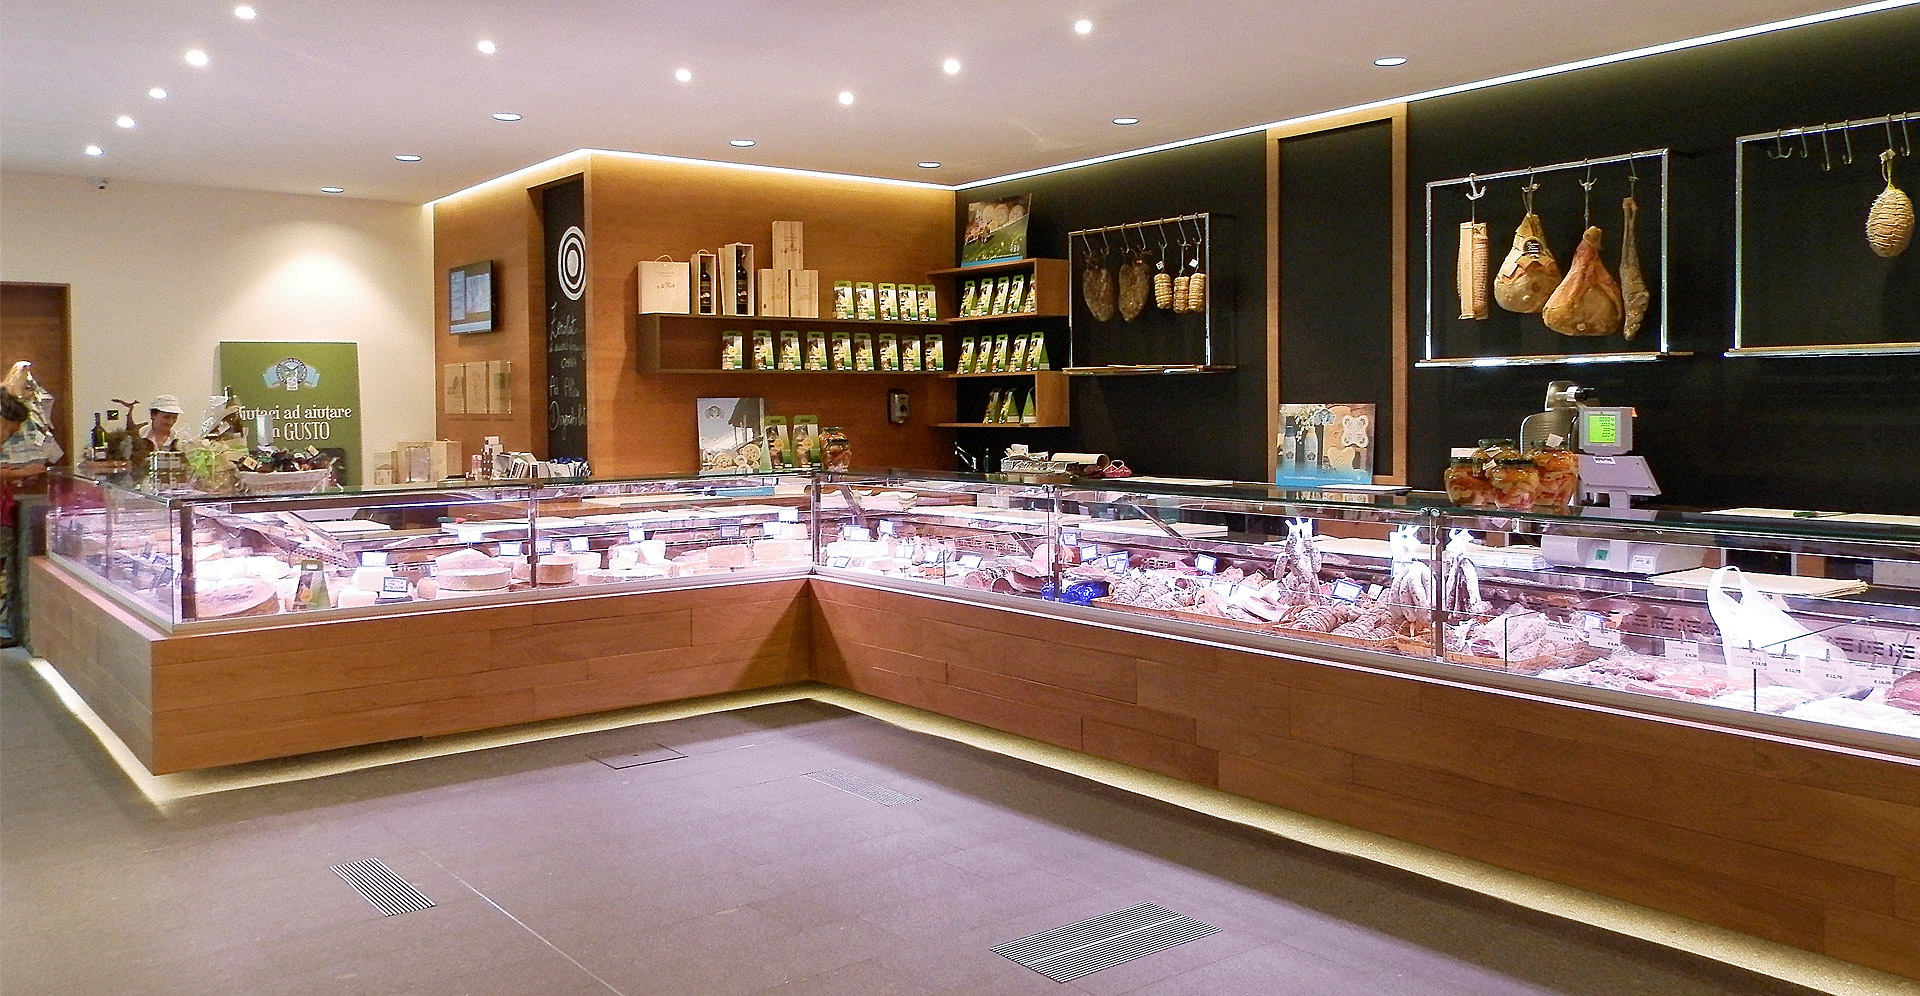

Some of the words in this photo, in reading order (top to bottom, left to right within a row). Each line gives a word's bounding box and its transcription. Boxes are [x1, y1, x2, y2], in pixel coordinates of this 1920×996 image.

[239, 405, 280, 420] iutaci
[283, 405, 300, 420] ad
[304, 404, 352, 420] aiutare
[284, 421, 330, 441] GUSTO
